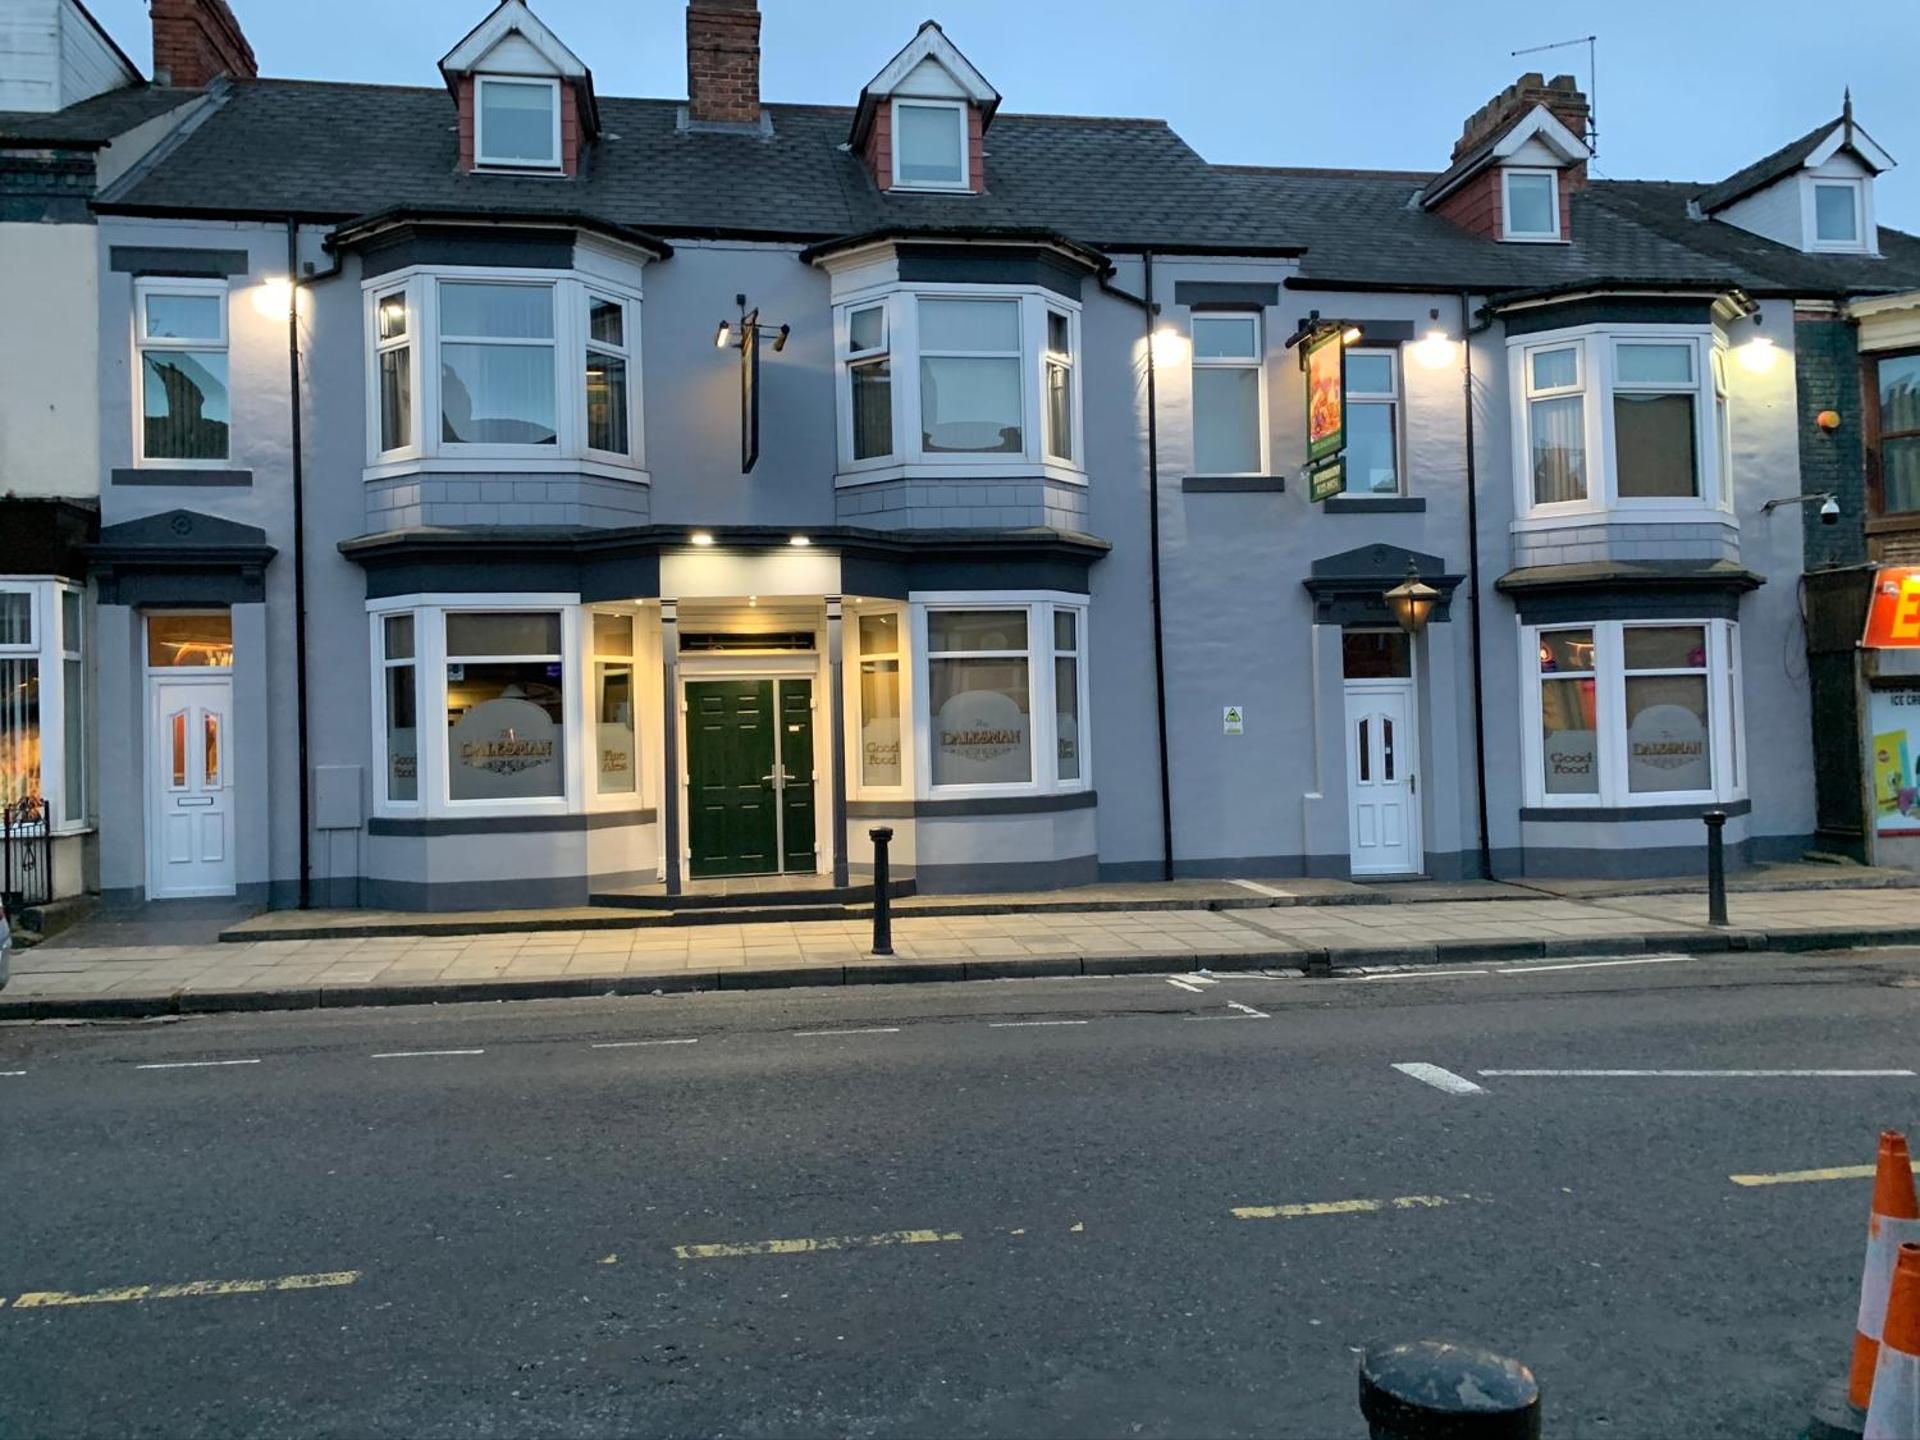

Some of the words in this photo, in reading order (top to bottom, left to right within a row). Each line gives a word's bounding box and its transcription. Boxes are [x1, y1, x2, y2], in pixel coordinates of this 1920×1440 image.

[866, 741, 899, 753] Good
[869, 753, 897, 765] Food
[1551, 752, 1592, 763] Good
[1554, 763, 1590, 774] Food
